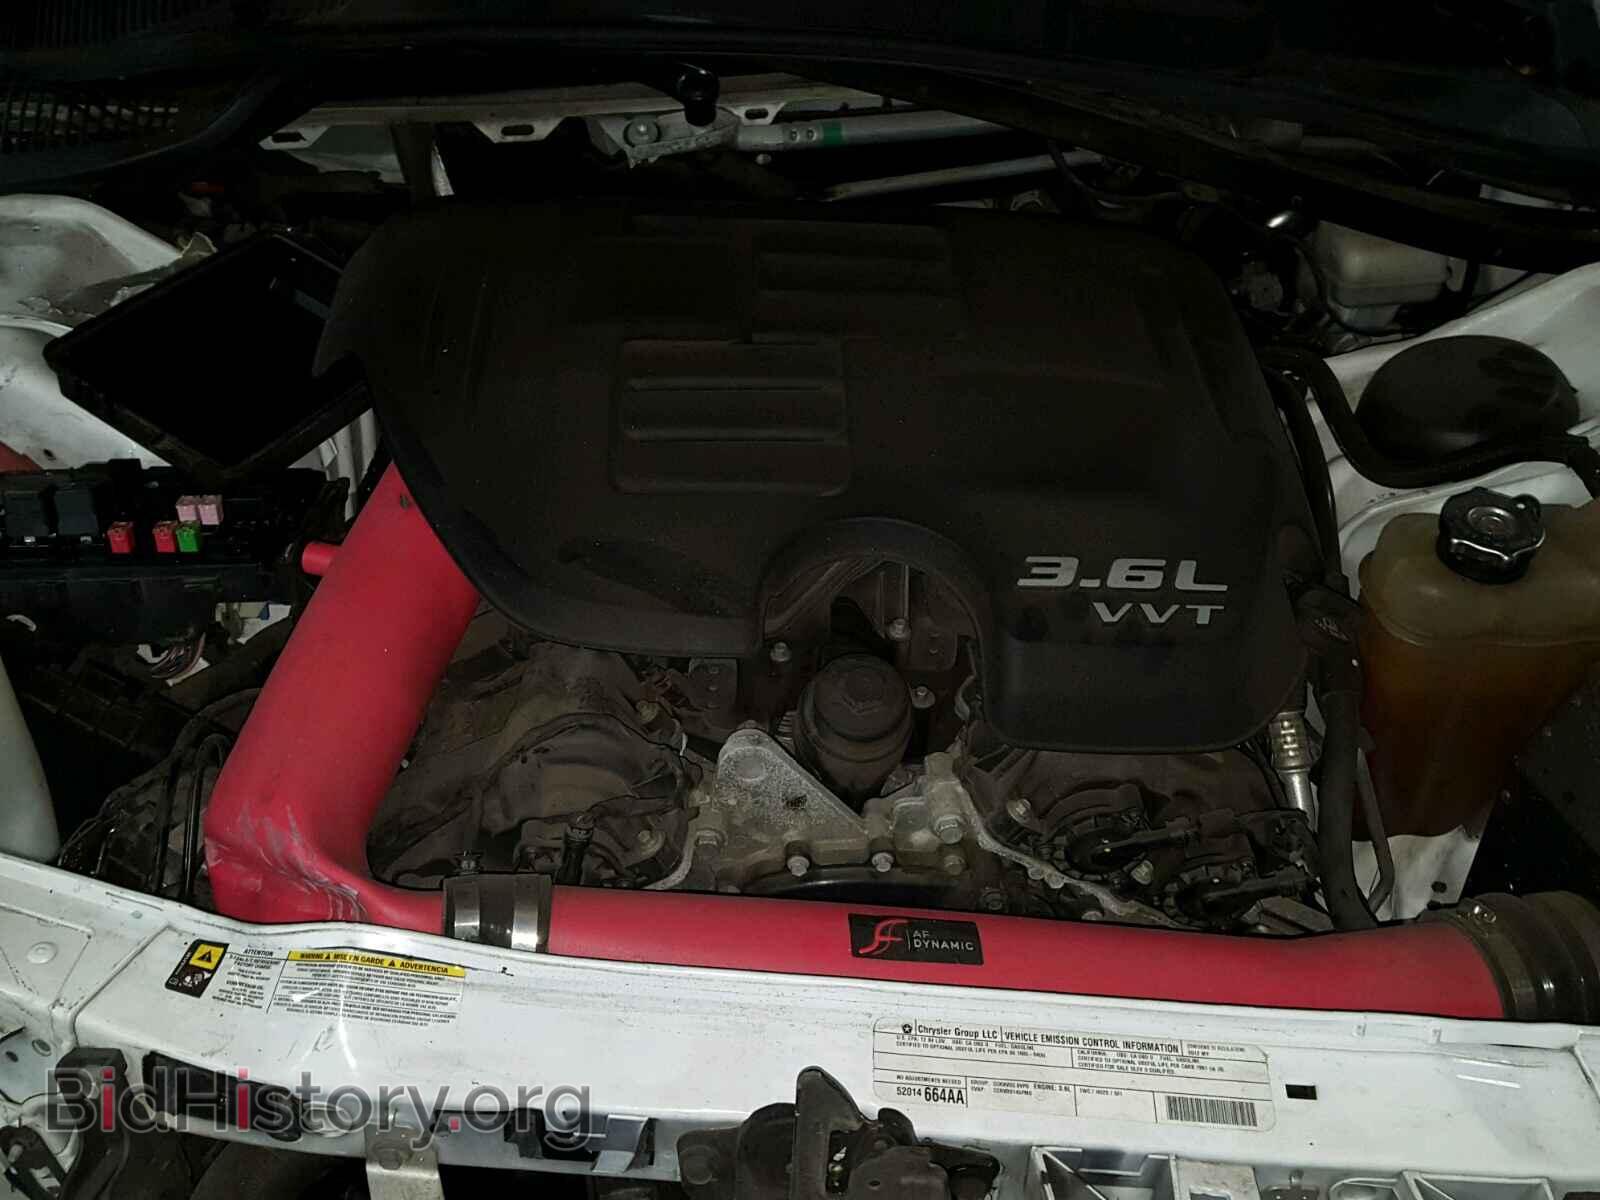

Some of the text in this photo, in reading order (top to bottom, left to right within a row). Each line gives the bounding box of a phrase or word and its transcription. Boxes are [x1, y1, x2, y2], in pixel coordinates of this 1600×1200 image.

[1017, 556, 1228, 592] 3.6L
[1092, 602, 1225, 625] VVT
[913, 939, 975, 951] DYNAMIC
[360, 956, 385, 966] GARDE
[399, 961, 449, 974] ADVERTENCIA
[918, 1024, 998, 1039] Chrysler Group LLC
[1004, 1031, 1038, 1042] VEHICLE
[1041, 1034, 1080, 1045] EMISSION
[1082, 1037, 1120, 1049] CONTROL
[1122, 1040, 1179, 1053] INFORMATION
[896, 1086, 922, 1096] 52014
[924, 1086, 965, 1104] 664AA
